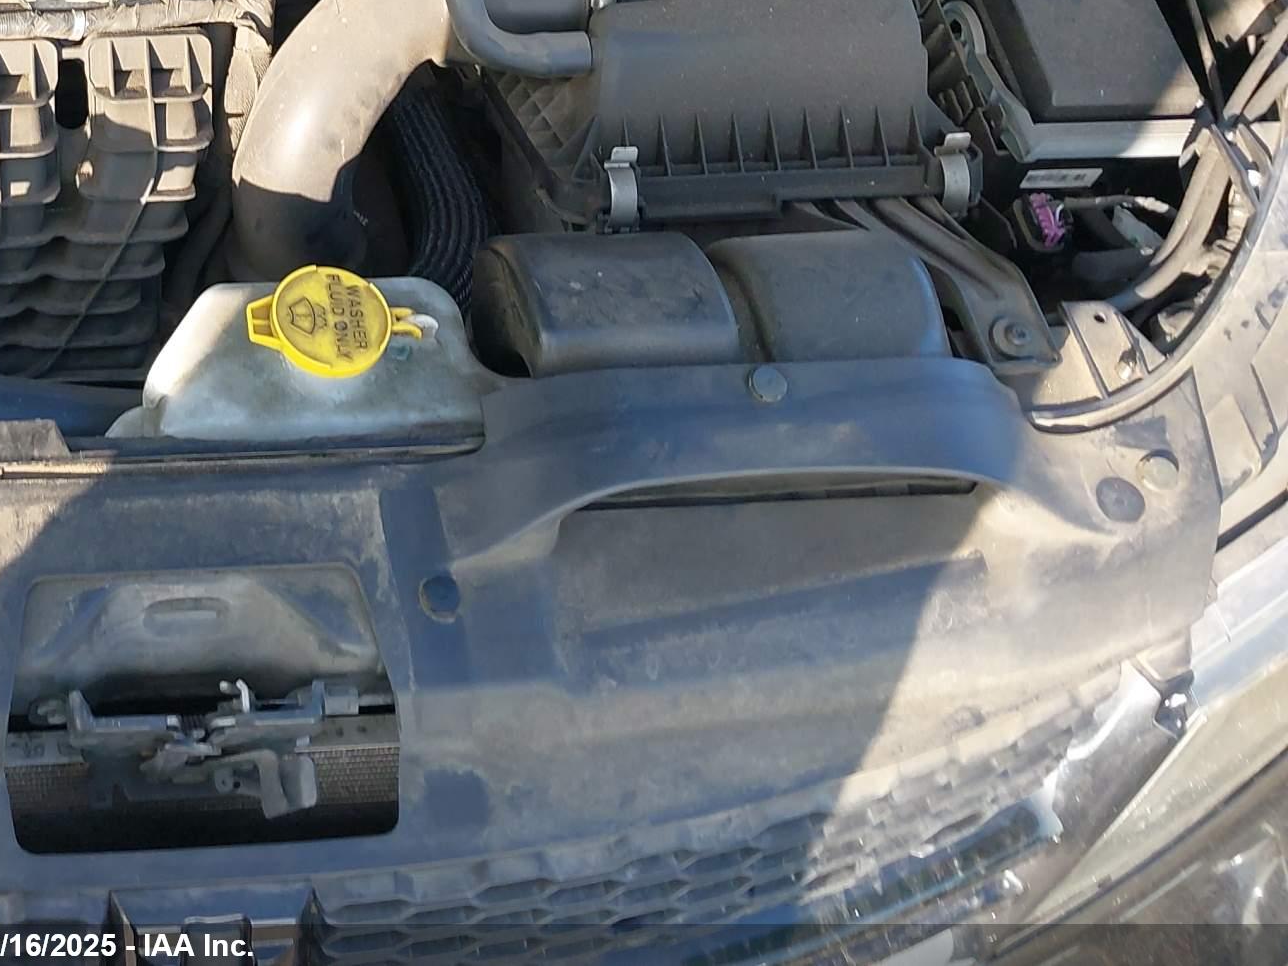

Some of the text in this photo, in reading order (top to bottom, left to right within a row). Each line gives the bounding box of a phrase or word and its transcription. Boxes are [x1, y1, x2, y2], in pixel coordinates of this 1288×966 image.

[327, 274, 354, 361] FLUID ONLY
[346, 284, 368, 351] WASHER
